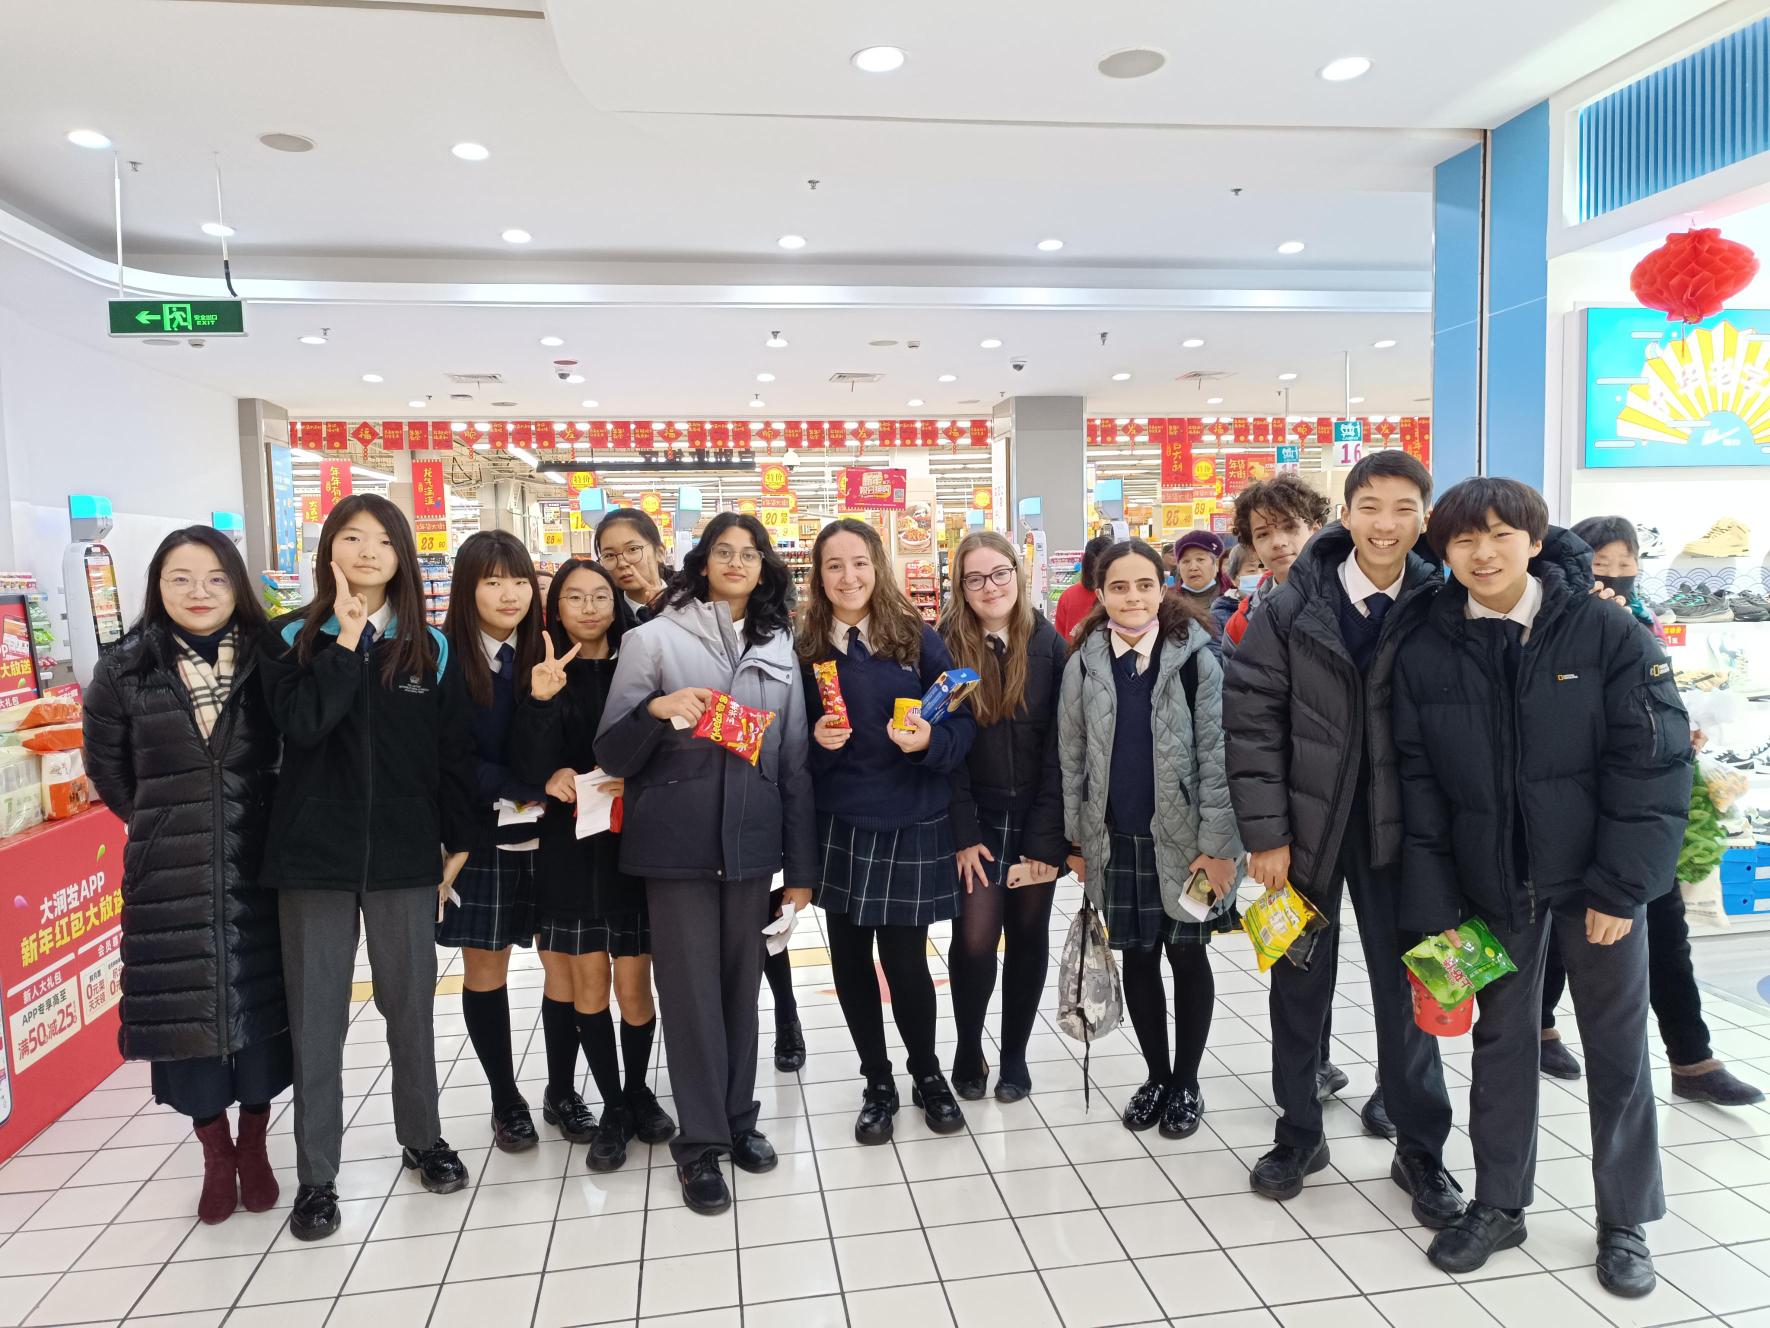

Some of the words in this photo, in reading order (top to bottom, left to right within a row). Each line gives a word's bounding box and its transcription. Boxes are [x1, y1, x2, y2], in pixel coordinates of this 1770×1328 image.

[358, 427, 372, 440] 福
[1341, 443, 1361, 464] 16
[0, 658, 32, 679] 大放送
[40, 871, 105, 924] 大润发APP
[21, 888, 124, 967] 新年红包大放送
[23, 971, 63, 1005] 新人大礼包
[22, 988, 67, 1026] APP专享高至
